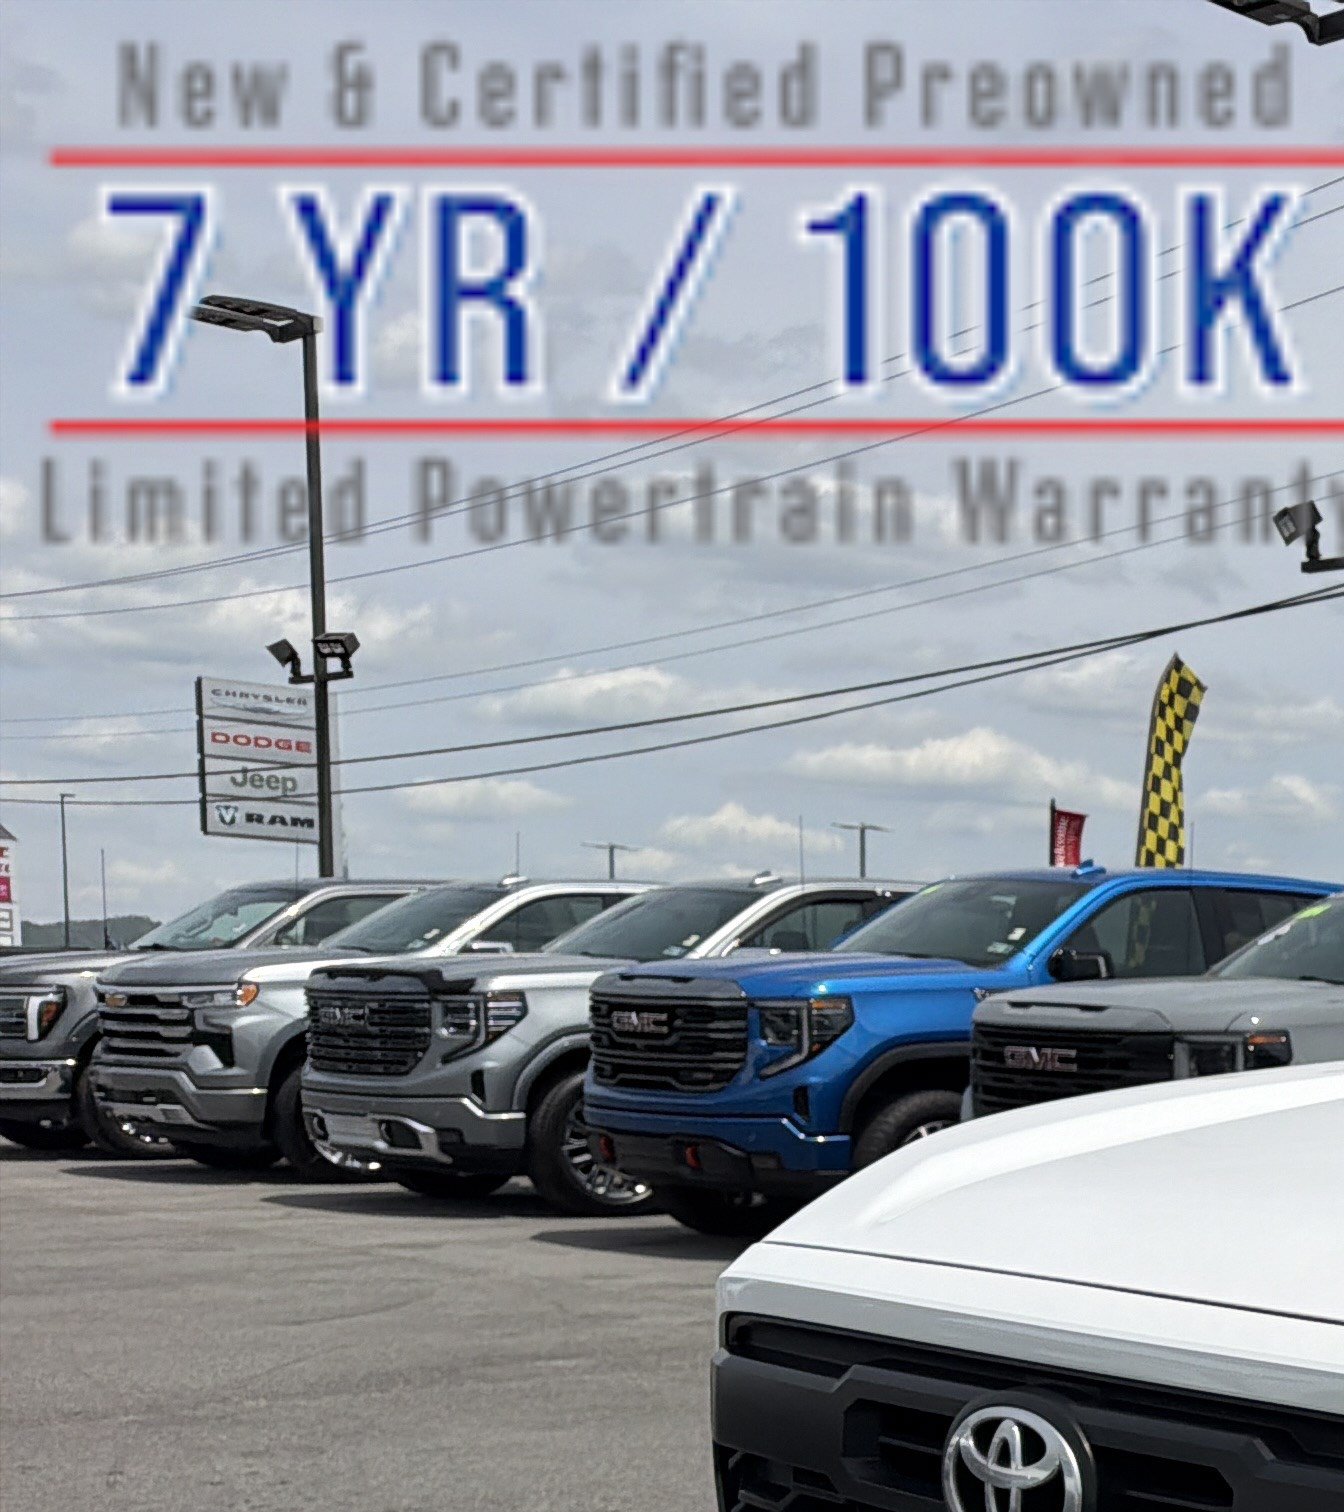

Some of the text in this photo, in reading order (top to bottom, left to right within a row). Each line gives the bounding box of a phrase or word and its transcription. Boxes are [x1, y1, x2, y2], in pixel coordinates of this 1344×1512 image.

[210, 688, 308, 706] CHRYSLER
[210, 731, 312, 754] DODGE
[229, 765, 299, 797] Jeep
[244, 812, 315, 829] RAM
[611, 1010, 669, 1033] GMC
[1003, 1045, 1078, 1073] GMC
